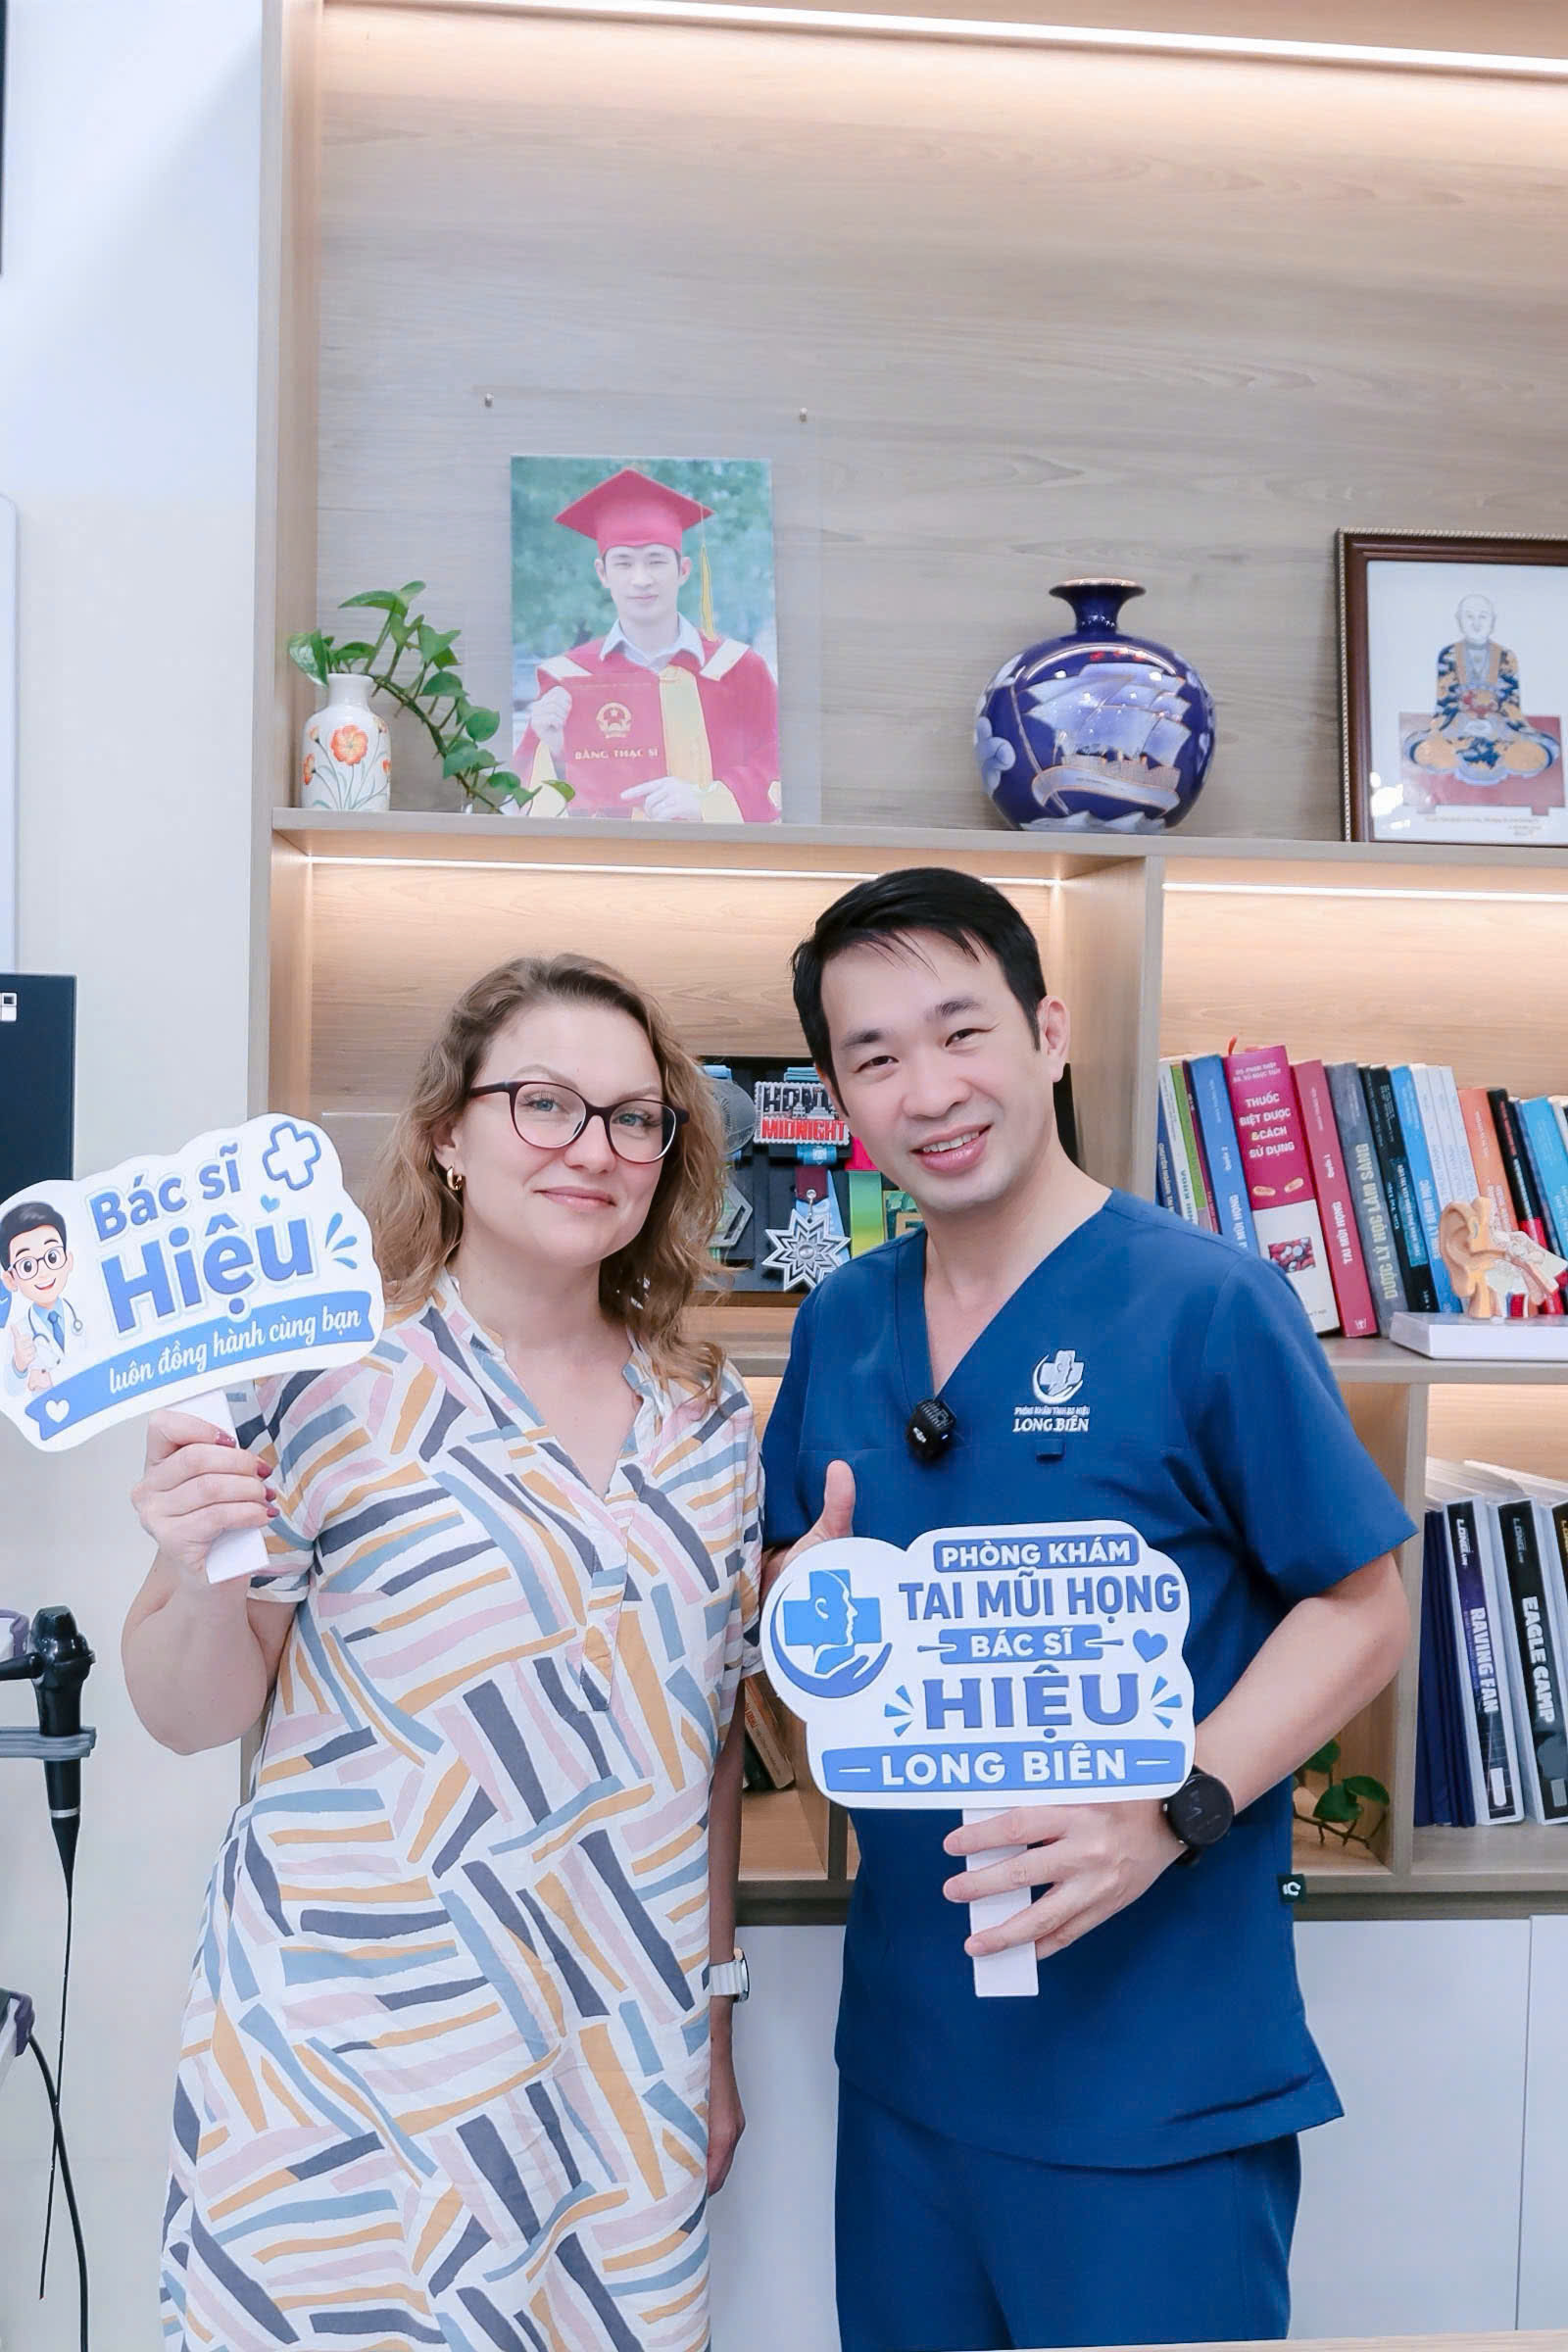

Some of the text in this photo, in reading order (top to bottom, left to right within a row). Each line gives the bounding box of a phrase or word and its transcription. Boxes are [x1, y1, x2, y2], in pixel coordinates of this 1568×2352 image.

[1246, 1090, 1280, 1108] THUỐC
[761, 1119, 846, 1141] MIDNIGHT
[1240, 1112, 1261, 1127] BIỆT
[1355, 1143, 1374, 1181] SÀNG
[89, 1143, 242, 1242] Bác sĩ
[1362, 1182, 1381, 1213] LÂM
[1332, 1200, 1346, 1227] HỌNG
[1369, 1214, 1388, 1243] HỌC
[1341, 1248, 1353, 1265] TAI
[1372, 1246, 1391, 1262] LÝ
[101, 1212, 315, 1334] Hiệu
[1379, 1262, 1398, 1300] DƯỢC
[109, 1304, 362, 1394] luôn đồng hành cùng bạn
[1012, 1414, 1090, 1433] LONG BIÊN
[942, 1537, 1131, 1567] PHÒNG KHÁM
[899, 1566, 1182, 1624] TAI MŨI HỌNG
[970, 1625, 1074, 1659] BÁC SĨ
[1470, 1606, 1494, 1676] RAVING
[1522, 1595, 1556, 1723] EAGLE CAMP
[922, 1665, 1140, 1739] HIỆU
[1480, 1678, 1499, 1714] FAN
[881, 1740, 1126, 1786] LONG BIÊN
